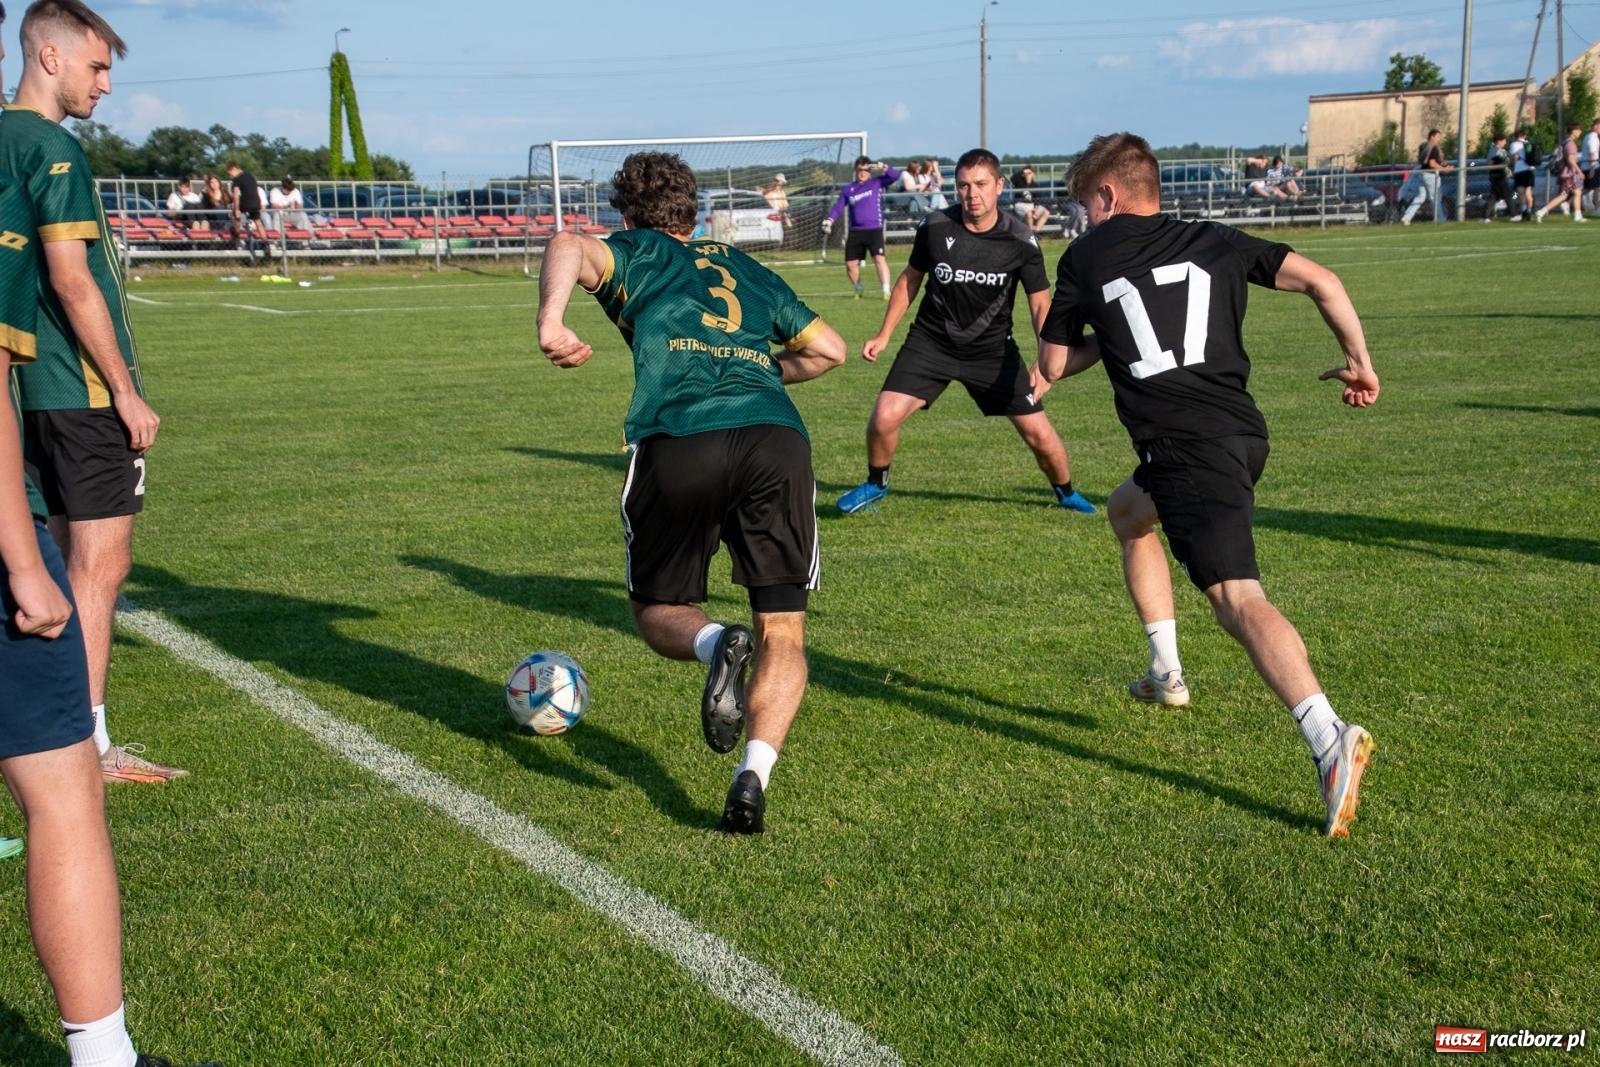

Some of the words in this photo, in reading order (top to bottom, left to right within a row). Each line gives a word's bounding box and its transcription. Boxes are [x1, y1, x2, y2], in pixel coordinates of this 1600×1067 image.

[695, 258, 742, 333] 3
[954, 269, 1007, 286] SPORT
[1102, 261, 1211, 380] 17
[733, 347, 771, 369] WIELKIE
